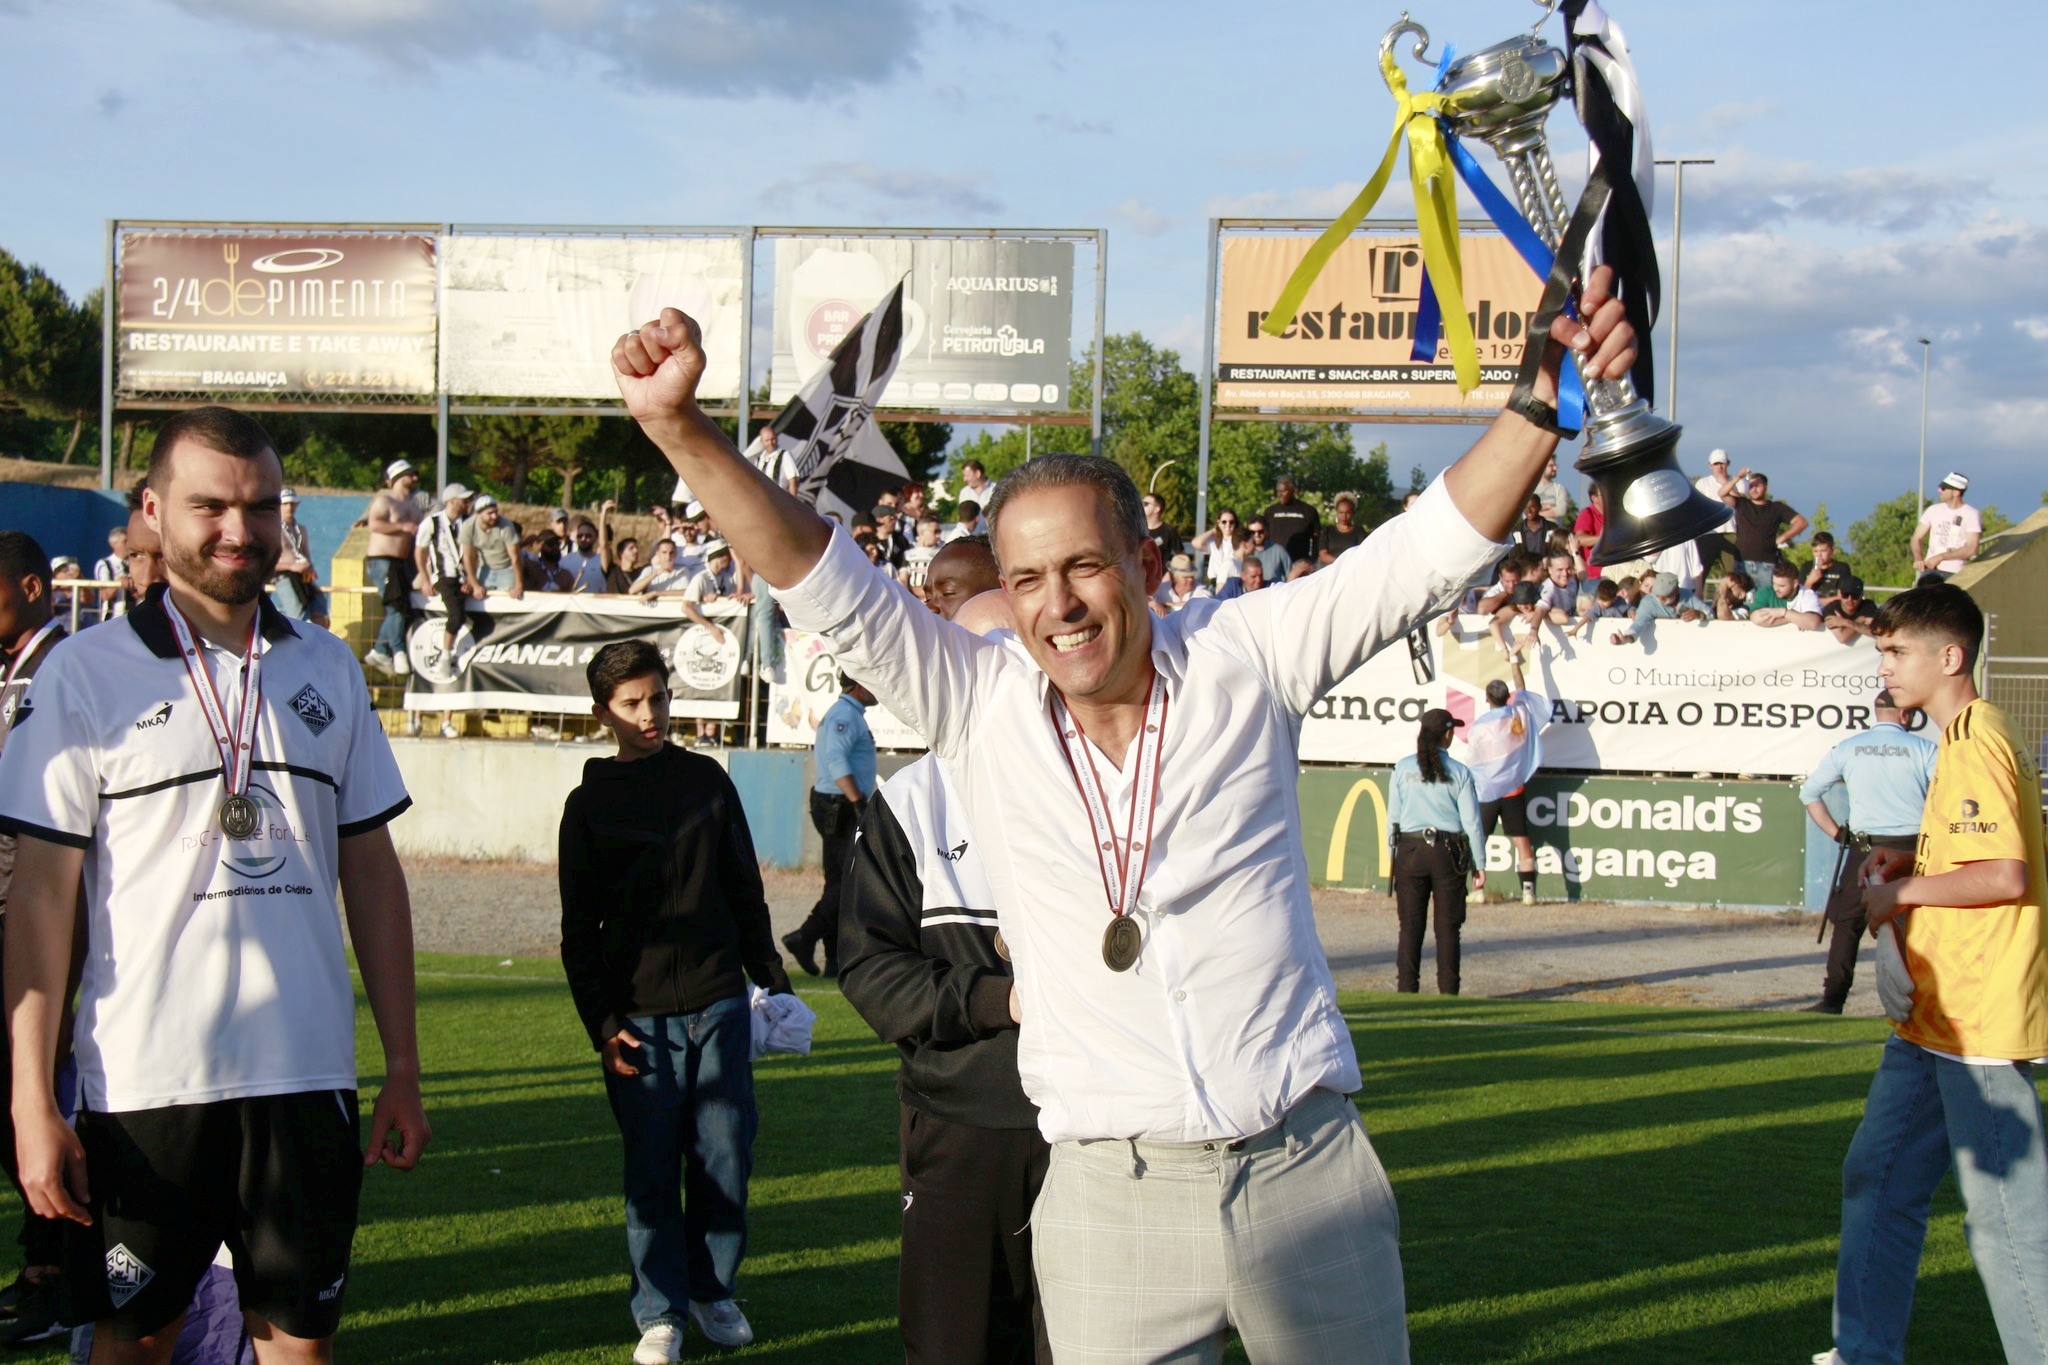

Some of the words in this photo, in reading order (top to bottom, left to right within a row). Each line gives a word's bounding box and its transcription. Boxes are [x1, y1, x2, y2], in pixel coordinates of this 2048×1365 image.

[153, 277, 201, 320] 2/4
[202, 243, 266, 319] de
[266, 279, 406, 318] PIMENTA
[946, 277, 1039, 295] AQUARIUS
[824, 310, 850, 323] BAR
[129, 333, 283, 353] RESTAURANTE
[288, 335, 301, 353] E
[308, 335, 362, 353] TAKE
[366, 336, 425, 353] AWAY
[817, 333, 846, 346] PRA
[1490, 344, 1524, 359] 197
[202, 370, 288, 388] BRAGANÇA
[325, 371, 356, 386] 273
[1230, 368, 1316, 380] RESTAURANTE
[1328, 369, 1399, 381] SNACK-BAR
[1239, 389, 1266, 398] Abade
[1268, 389, 1279, 398] de
[1361, 390, 1411, 401] BRAGANÇA
[471, 643, 575, 667] BIANCA
[1608, 666, 1626, 685] O
[1634, 667, 1756, 692] Município
[1763, 667, 1794, 689] de
[1802, 669, 1886, 696] Braga
[1309, 695, 1429, 726] ança
[1550, 699, 1669, 726] APOIA
[1677, 701, 1703, 726] O
[136, 716, 164, 731] MKA
[1854, 744, 1911, 758] POLÍCIA
[1526, 791, 1762, 833] cDonald's
[269, 823, 288, 841] for
[1949, 821, 1998, 835] BETANO
[193, 886, 266, 902] Intermediários
[268, 885, 282, 895] de
